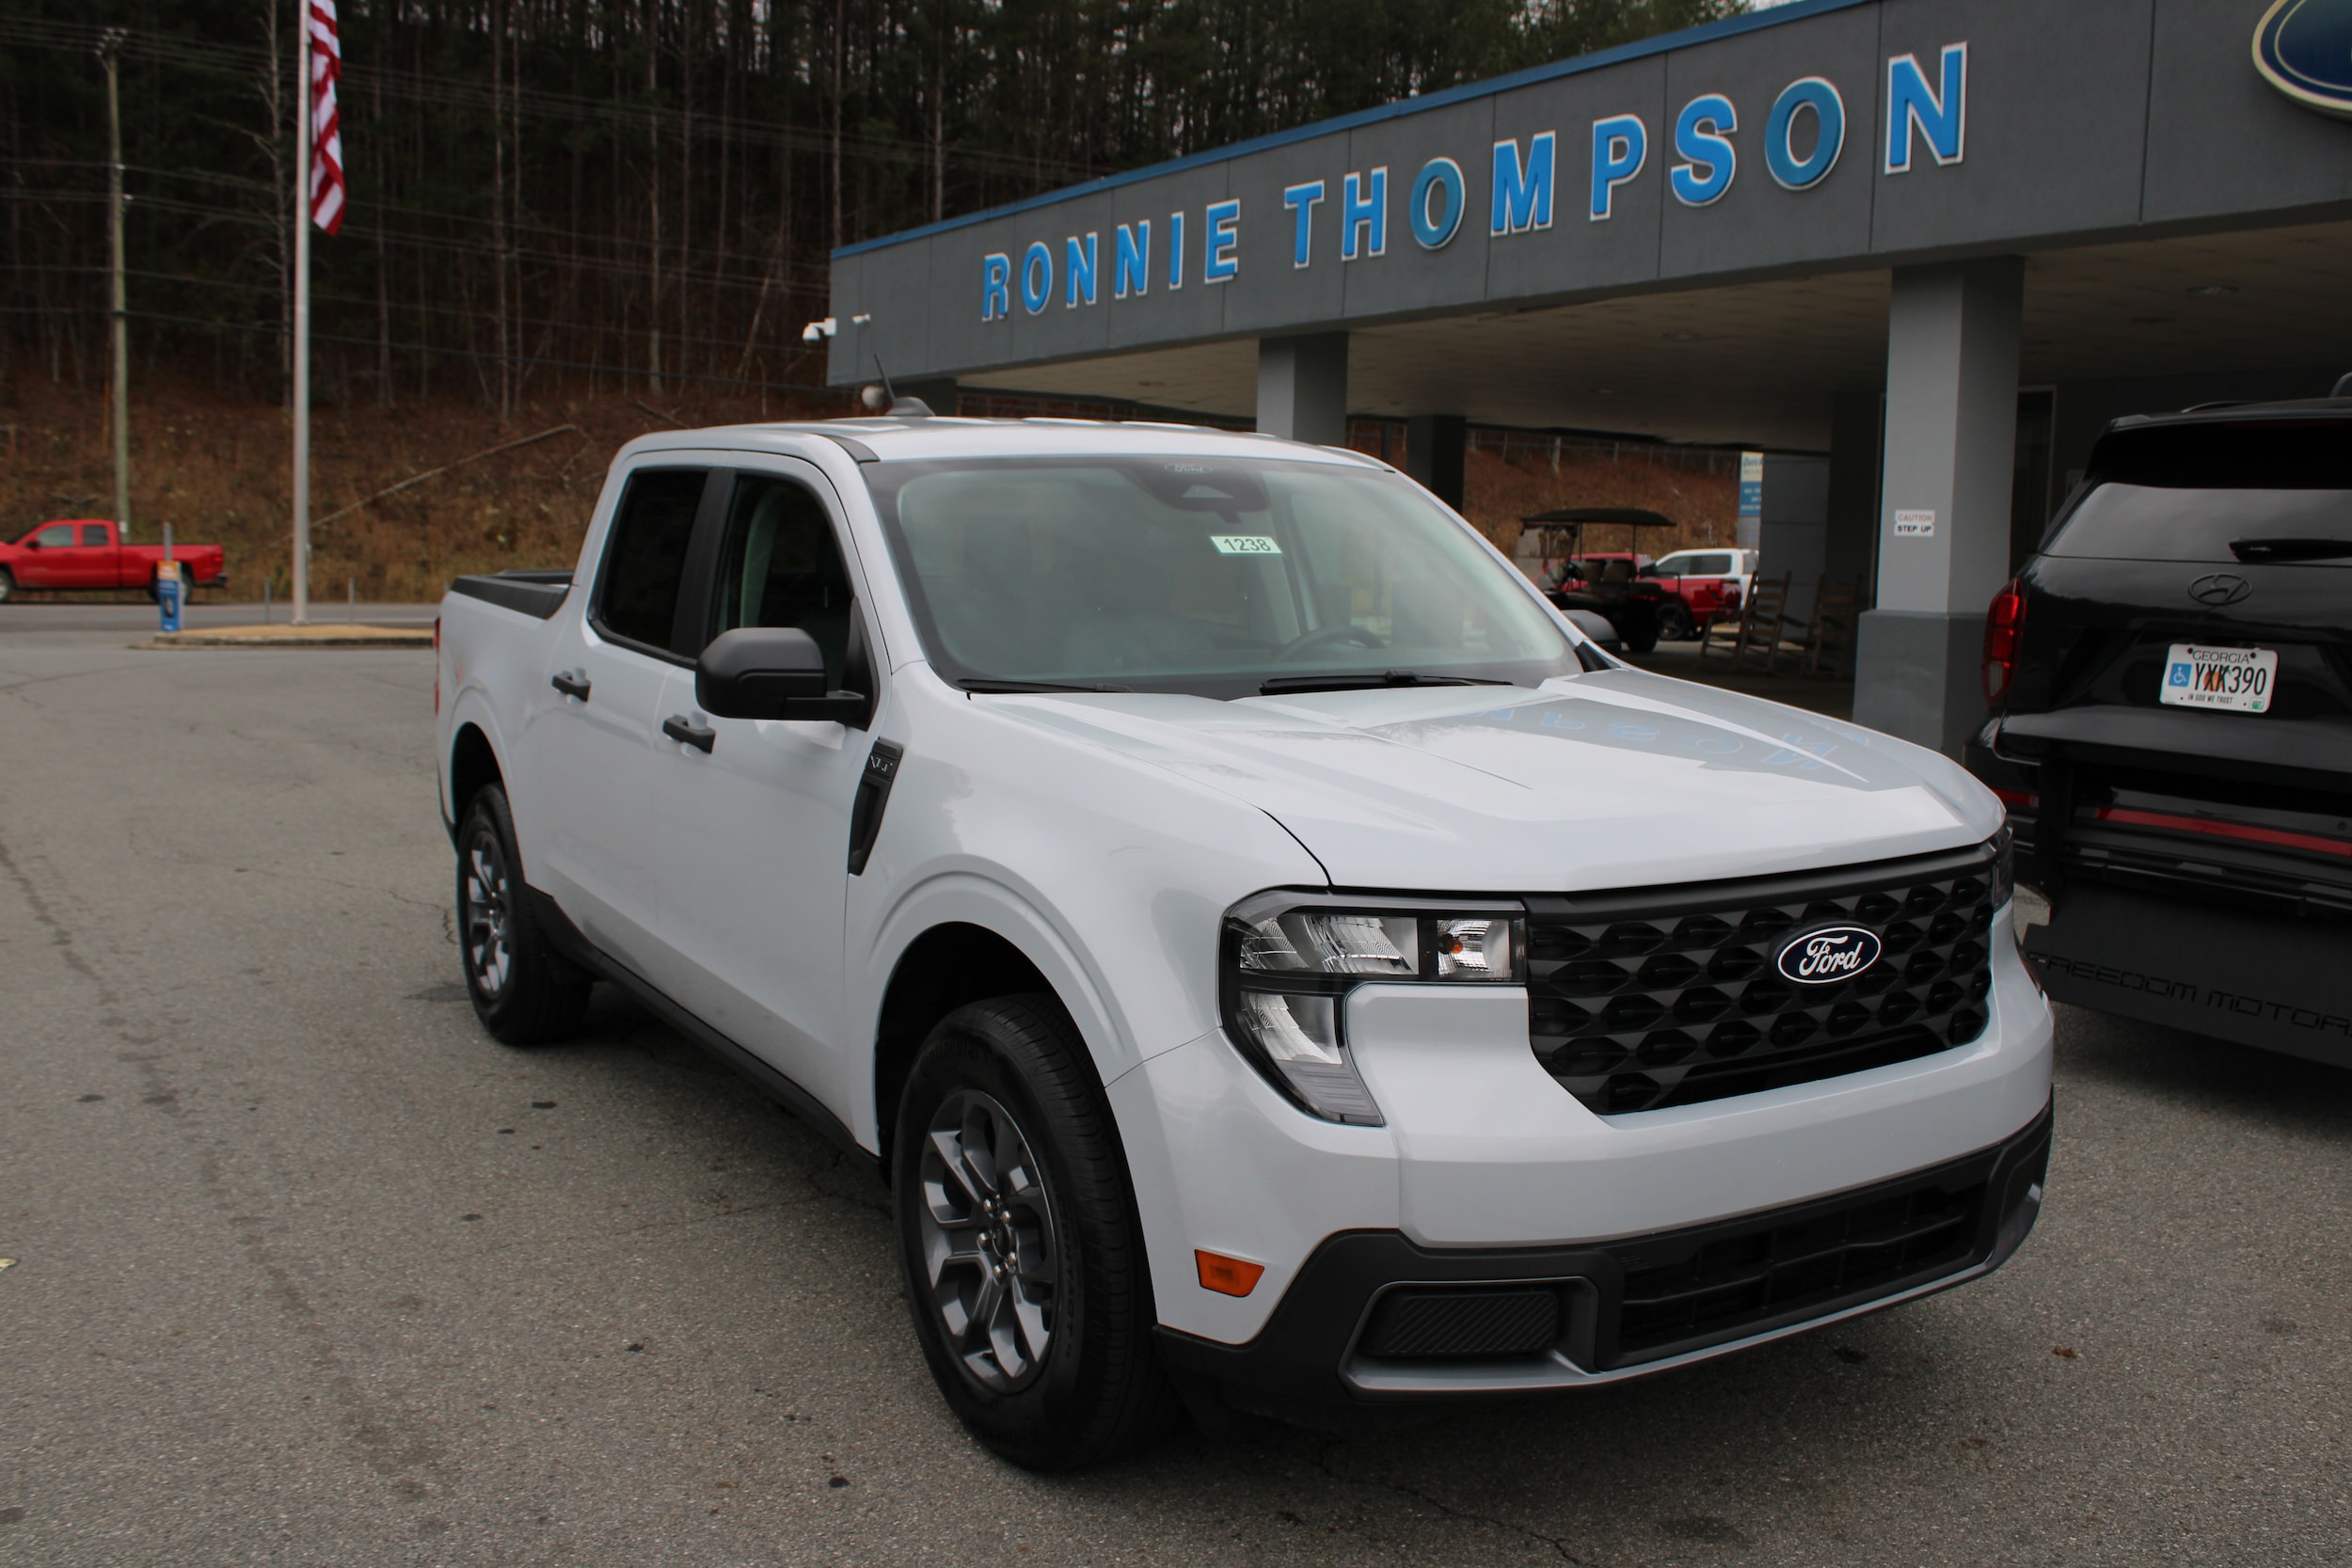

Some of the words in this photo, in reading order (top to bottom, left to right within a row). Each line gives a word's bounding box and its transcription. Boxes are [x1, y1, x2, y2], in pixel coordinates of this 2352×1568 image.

[982, 198, 1240, 322] RONNIE
[1283, 40, 1968, 269] THOMPSON
[1898, 514, 1932, 522] CAUTION
[1223, 538, 1272, 552] 1238
[2192, 650, 2249, 664] GEORGIA
[2194, 662, 2267, 696] YXK390
[1799, 935, 1863, 976] Ford
[2026, 951, 2198, 1004] FREEDOM
[2206, 990, 2352, 1037] MOTOR
